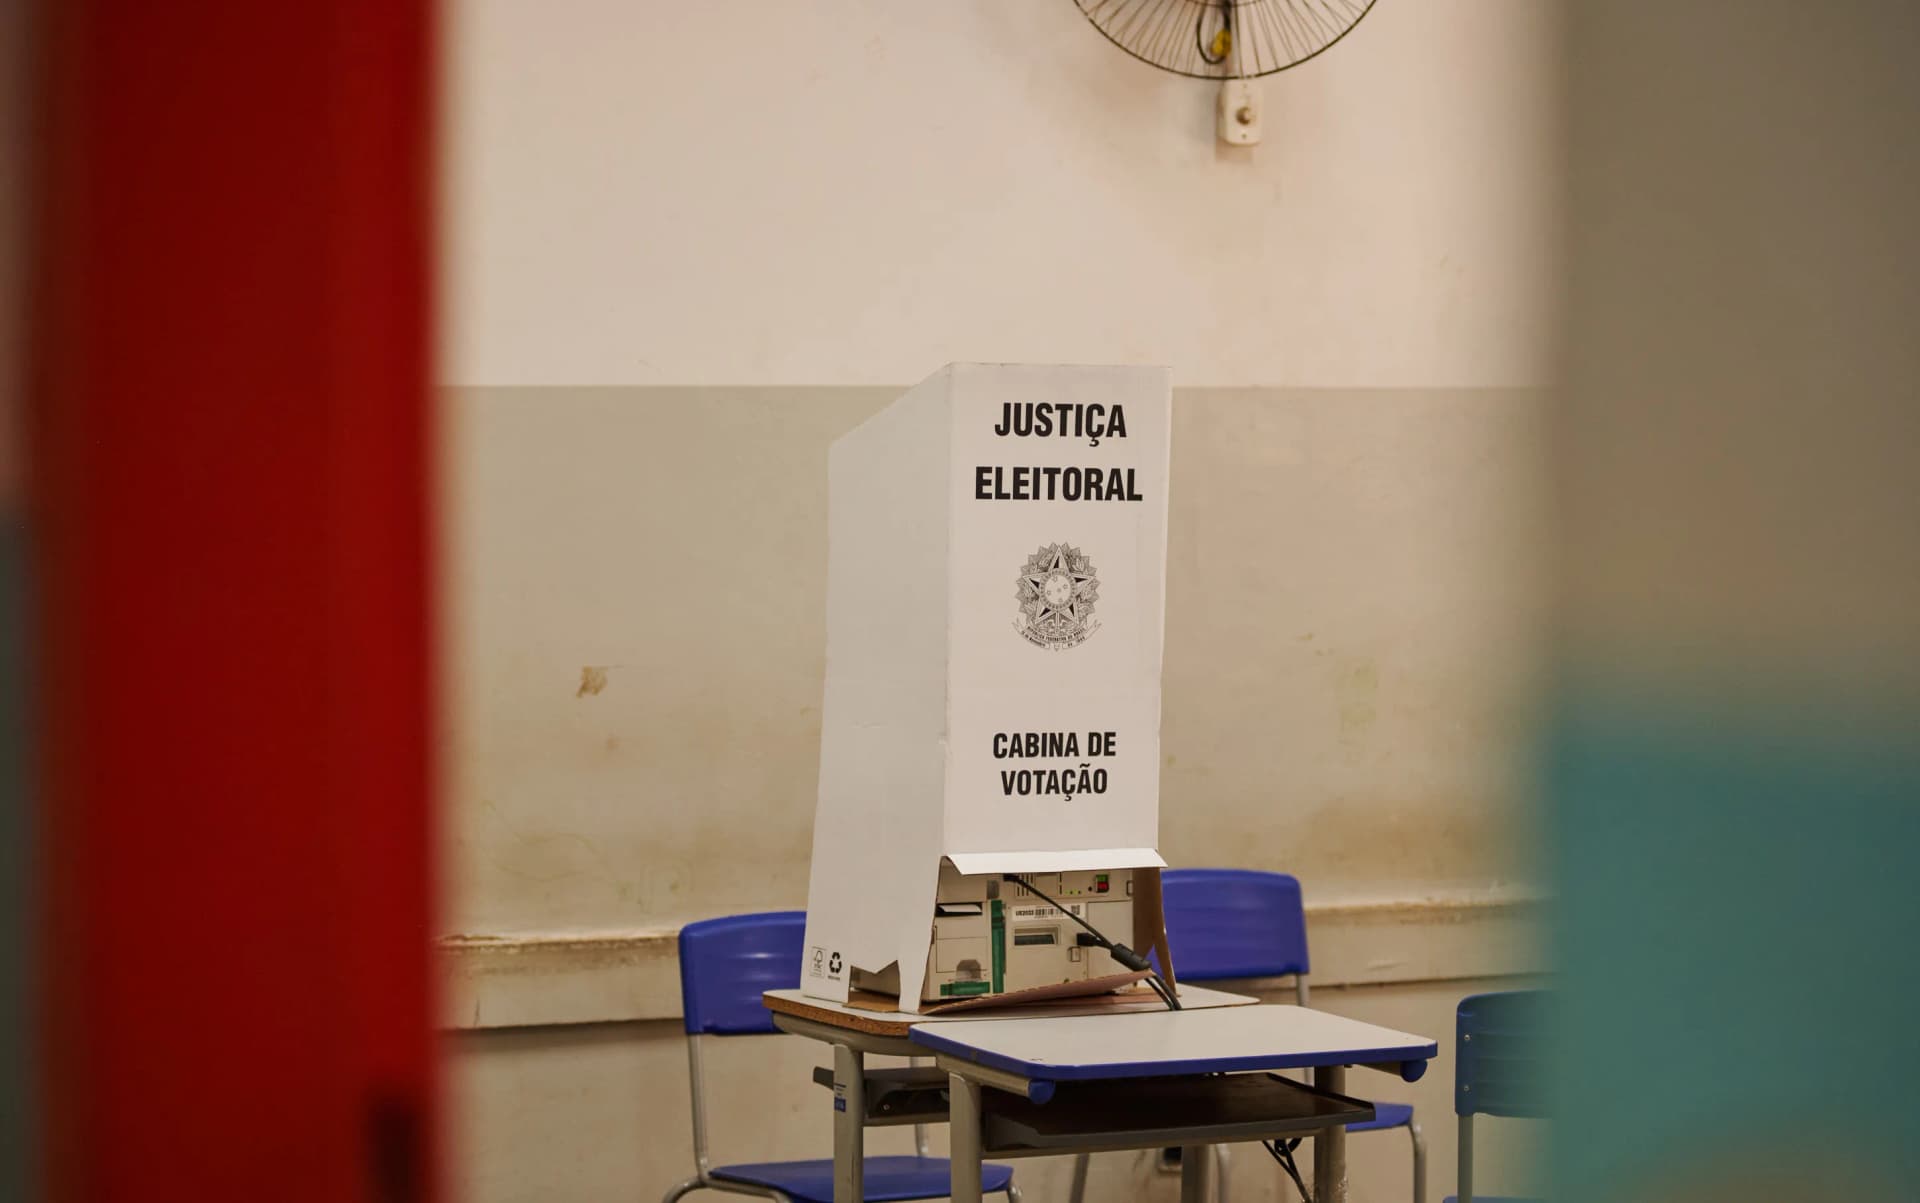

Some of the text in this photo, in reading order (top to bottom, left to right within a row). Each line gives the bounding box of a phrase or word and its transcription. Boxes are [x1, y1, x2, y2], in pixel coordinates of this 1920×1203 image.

[995, 402, 1127, 447] JUSTIÇA
[975, 466, 1143, 501] ELEITORAL
[993, 732, 1116, 759] CABINA DE
[1001, 763, 1108, 802] VOTAÇÃO
